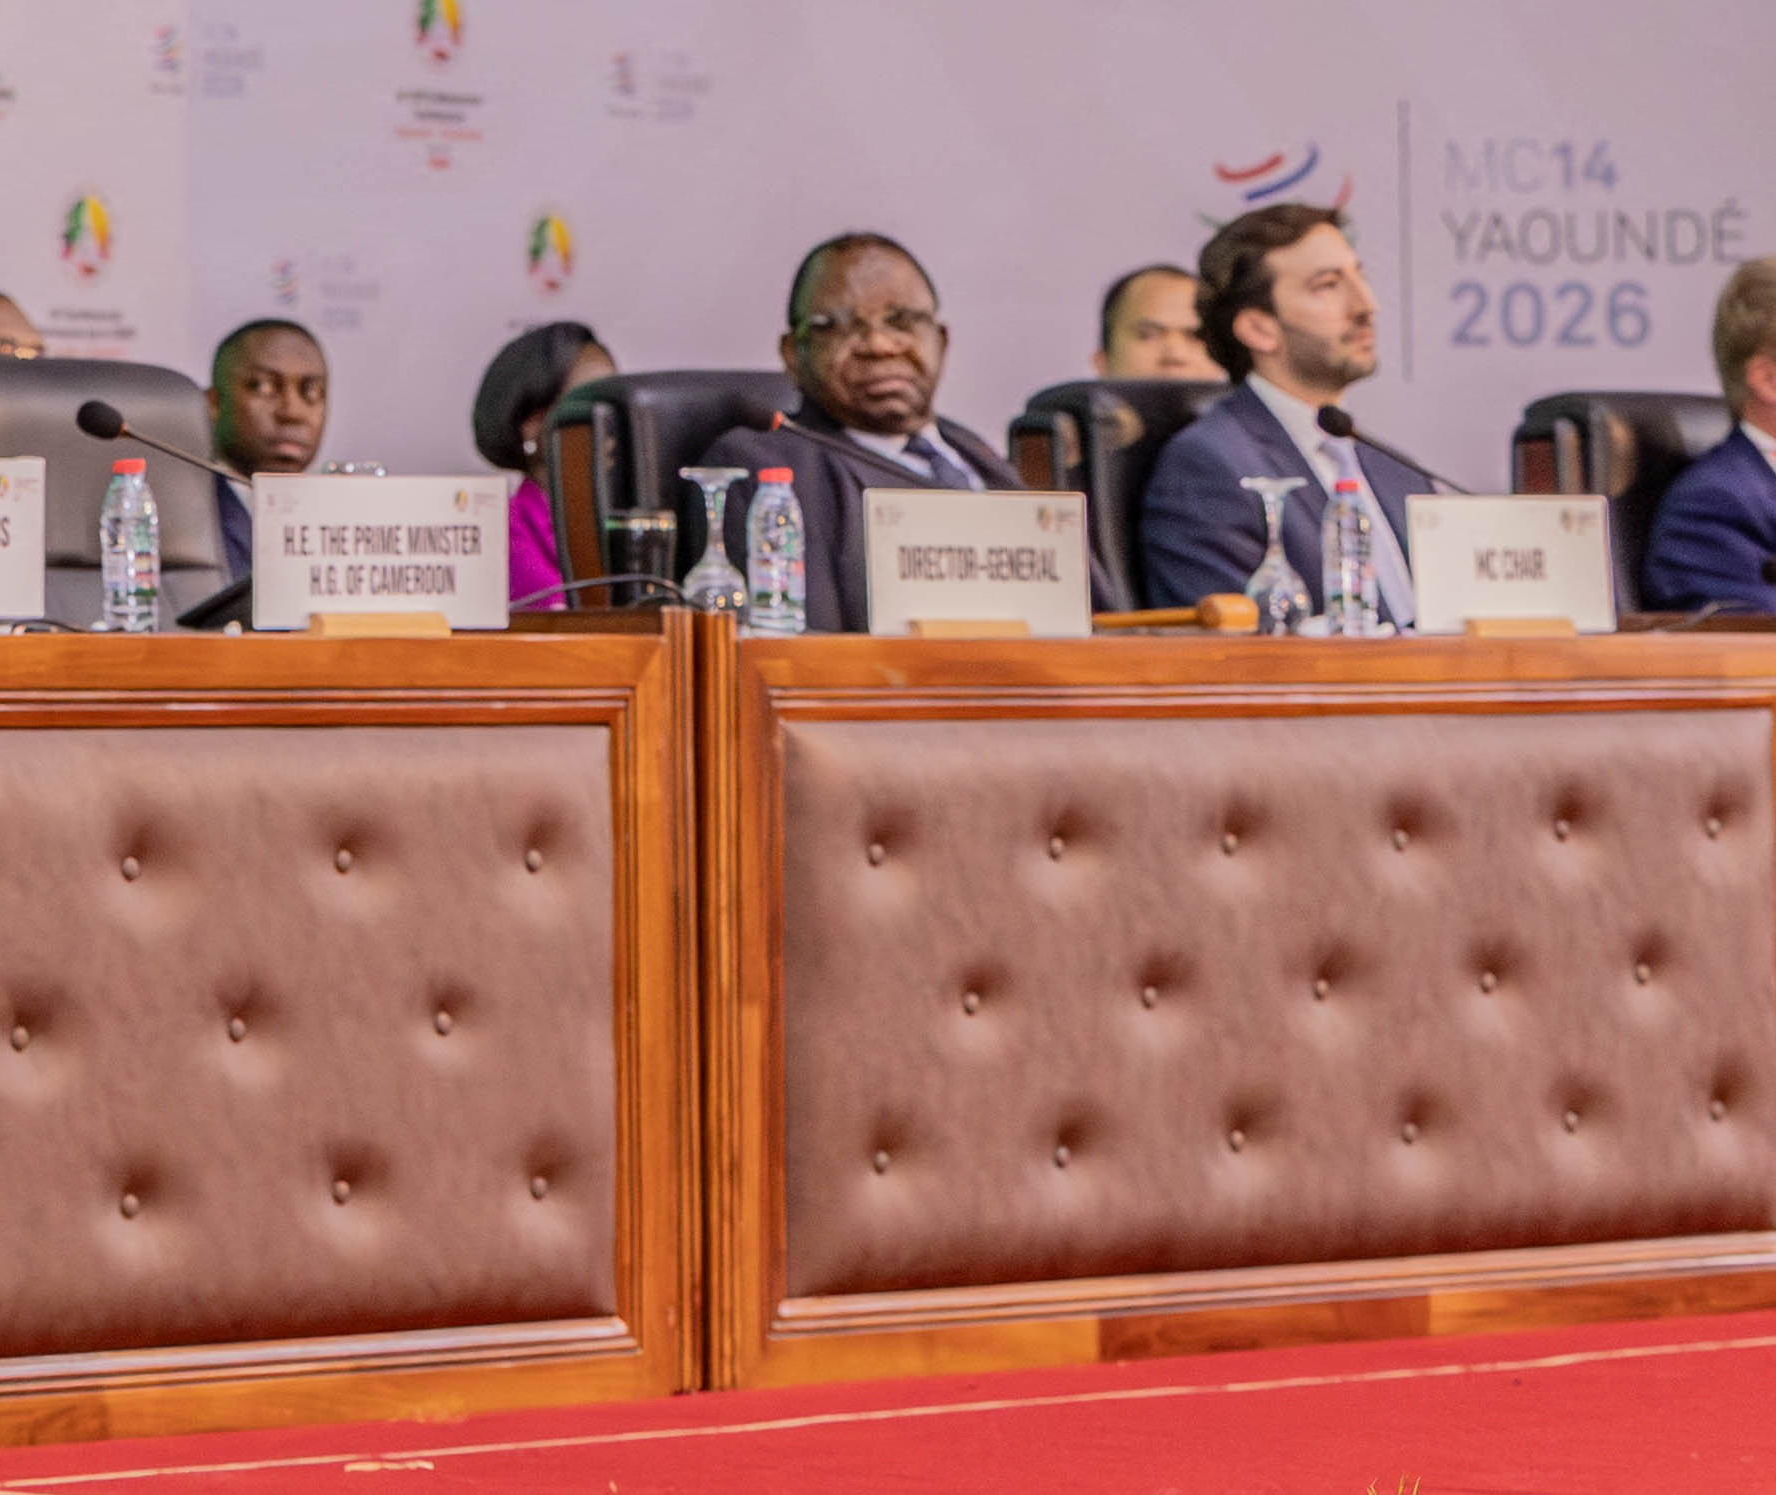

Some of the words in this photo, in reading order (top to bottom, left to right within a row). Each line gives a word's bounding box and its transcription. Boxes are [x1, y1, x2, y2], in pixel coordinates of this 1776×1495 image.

[1444, 138, 1621, 193] MC14
[1441, 197, 1751, 267] YAOUNDÉ
[1449, 280, 1654, 348] 2026
[283, 524, 314, 555] H.E.
[319, 524, 350, 555] THE
[354, 524, 402, 556] PRIME
[406, 524, 483, 556] MINISTER
[347, 565, 365, 596] OF
[369, 564, 457, 596] CAMEROON
